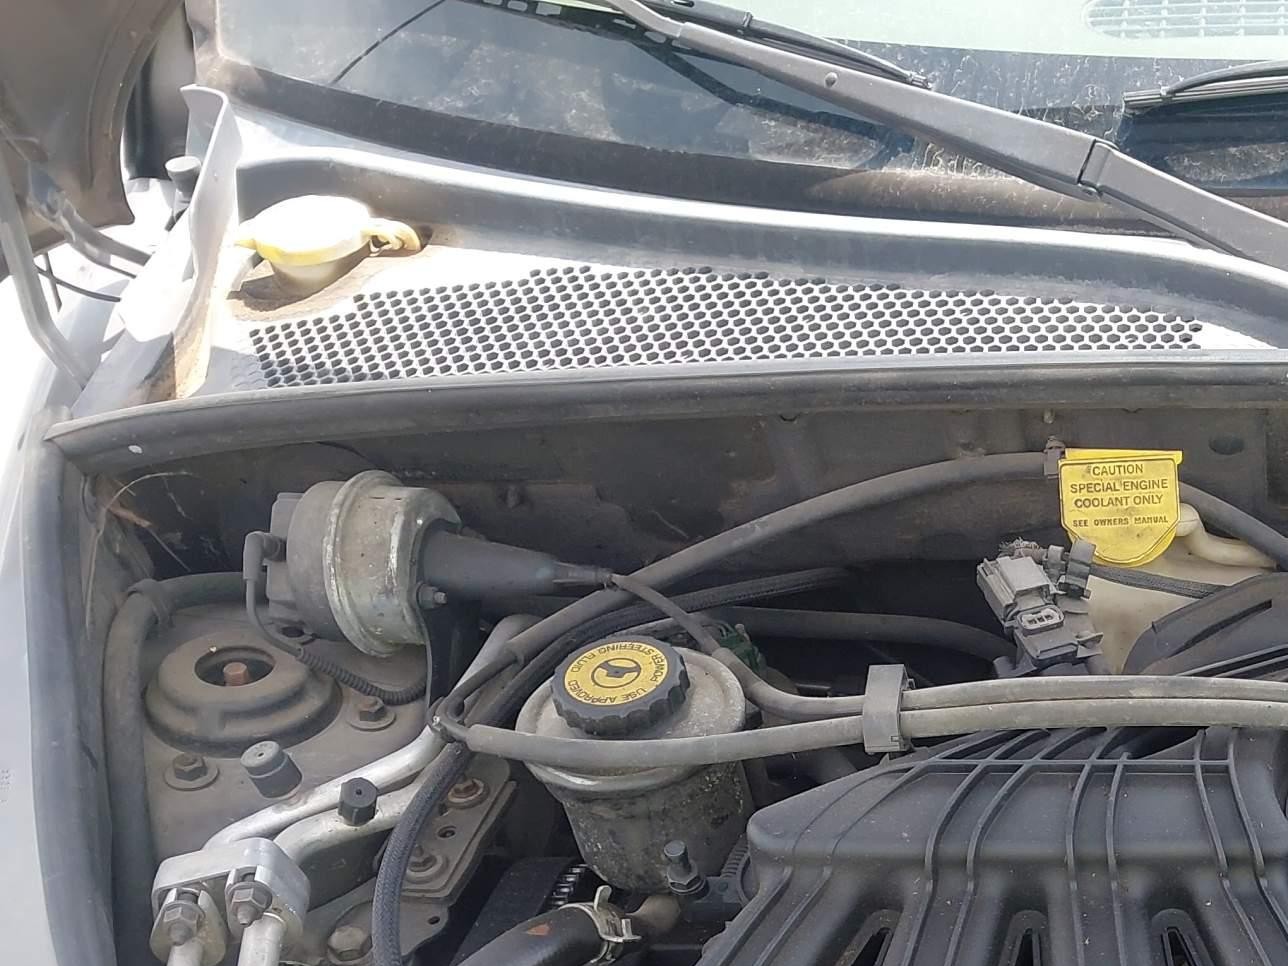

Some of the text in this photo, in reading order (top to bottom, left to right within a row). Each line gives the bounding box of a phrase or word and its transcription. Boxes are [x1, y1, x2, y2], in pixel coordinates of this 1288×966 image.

[1092, 464, 1144, 476] CAUTION
[1070, 478, 1169, 494] SPECIAL ENGINE
[1074, 494, 1163, 508] COOLANT ONLY
[1073, 515, 1168, 527] SEE OWNERS MANUAL
[571, 642, 666, 682] POWER STEERING FLUID
[567, 679, 647, 704] USE APPROVED
